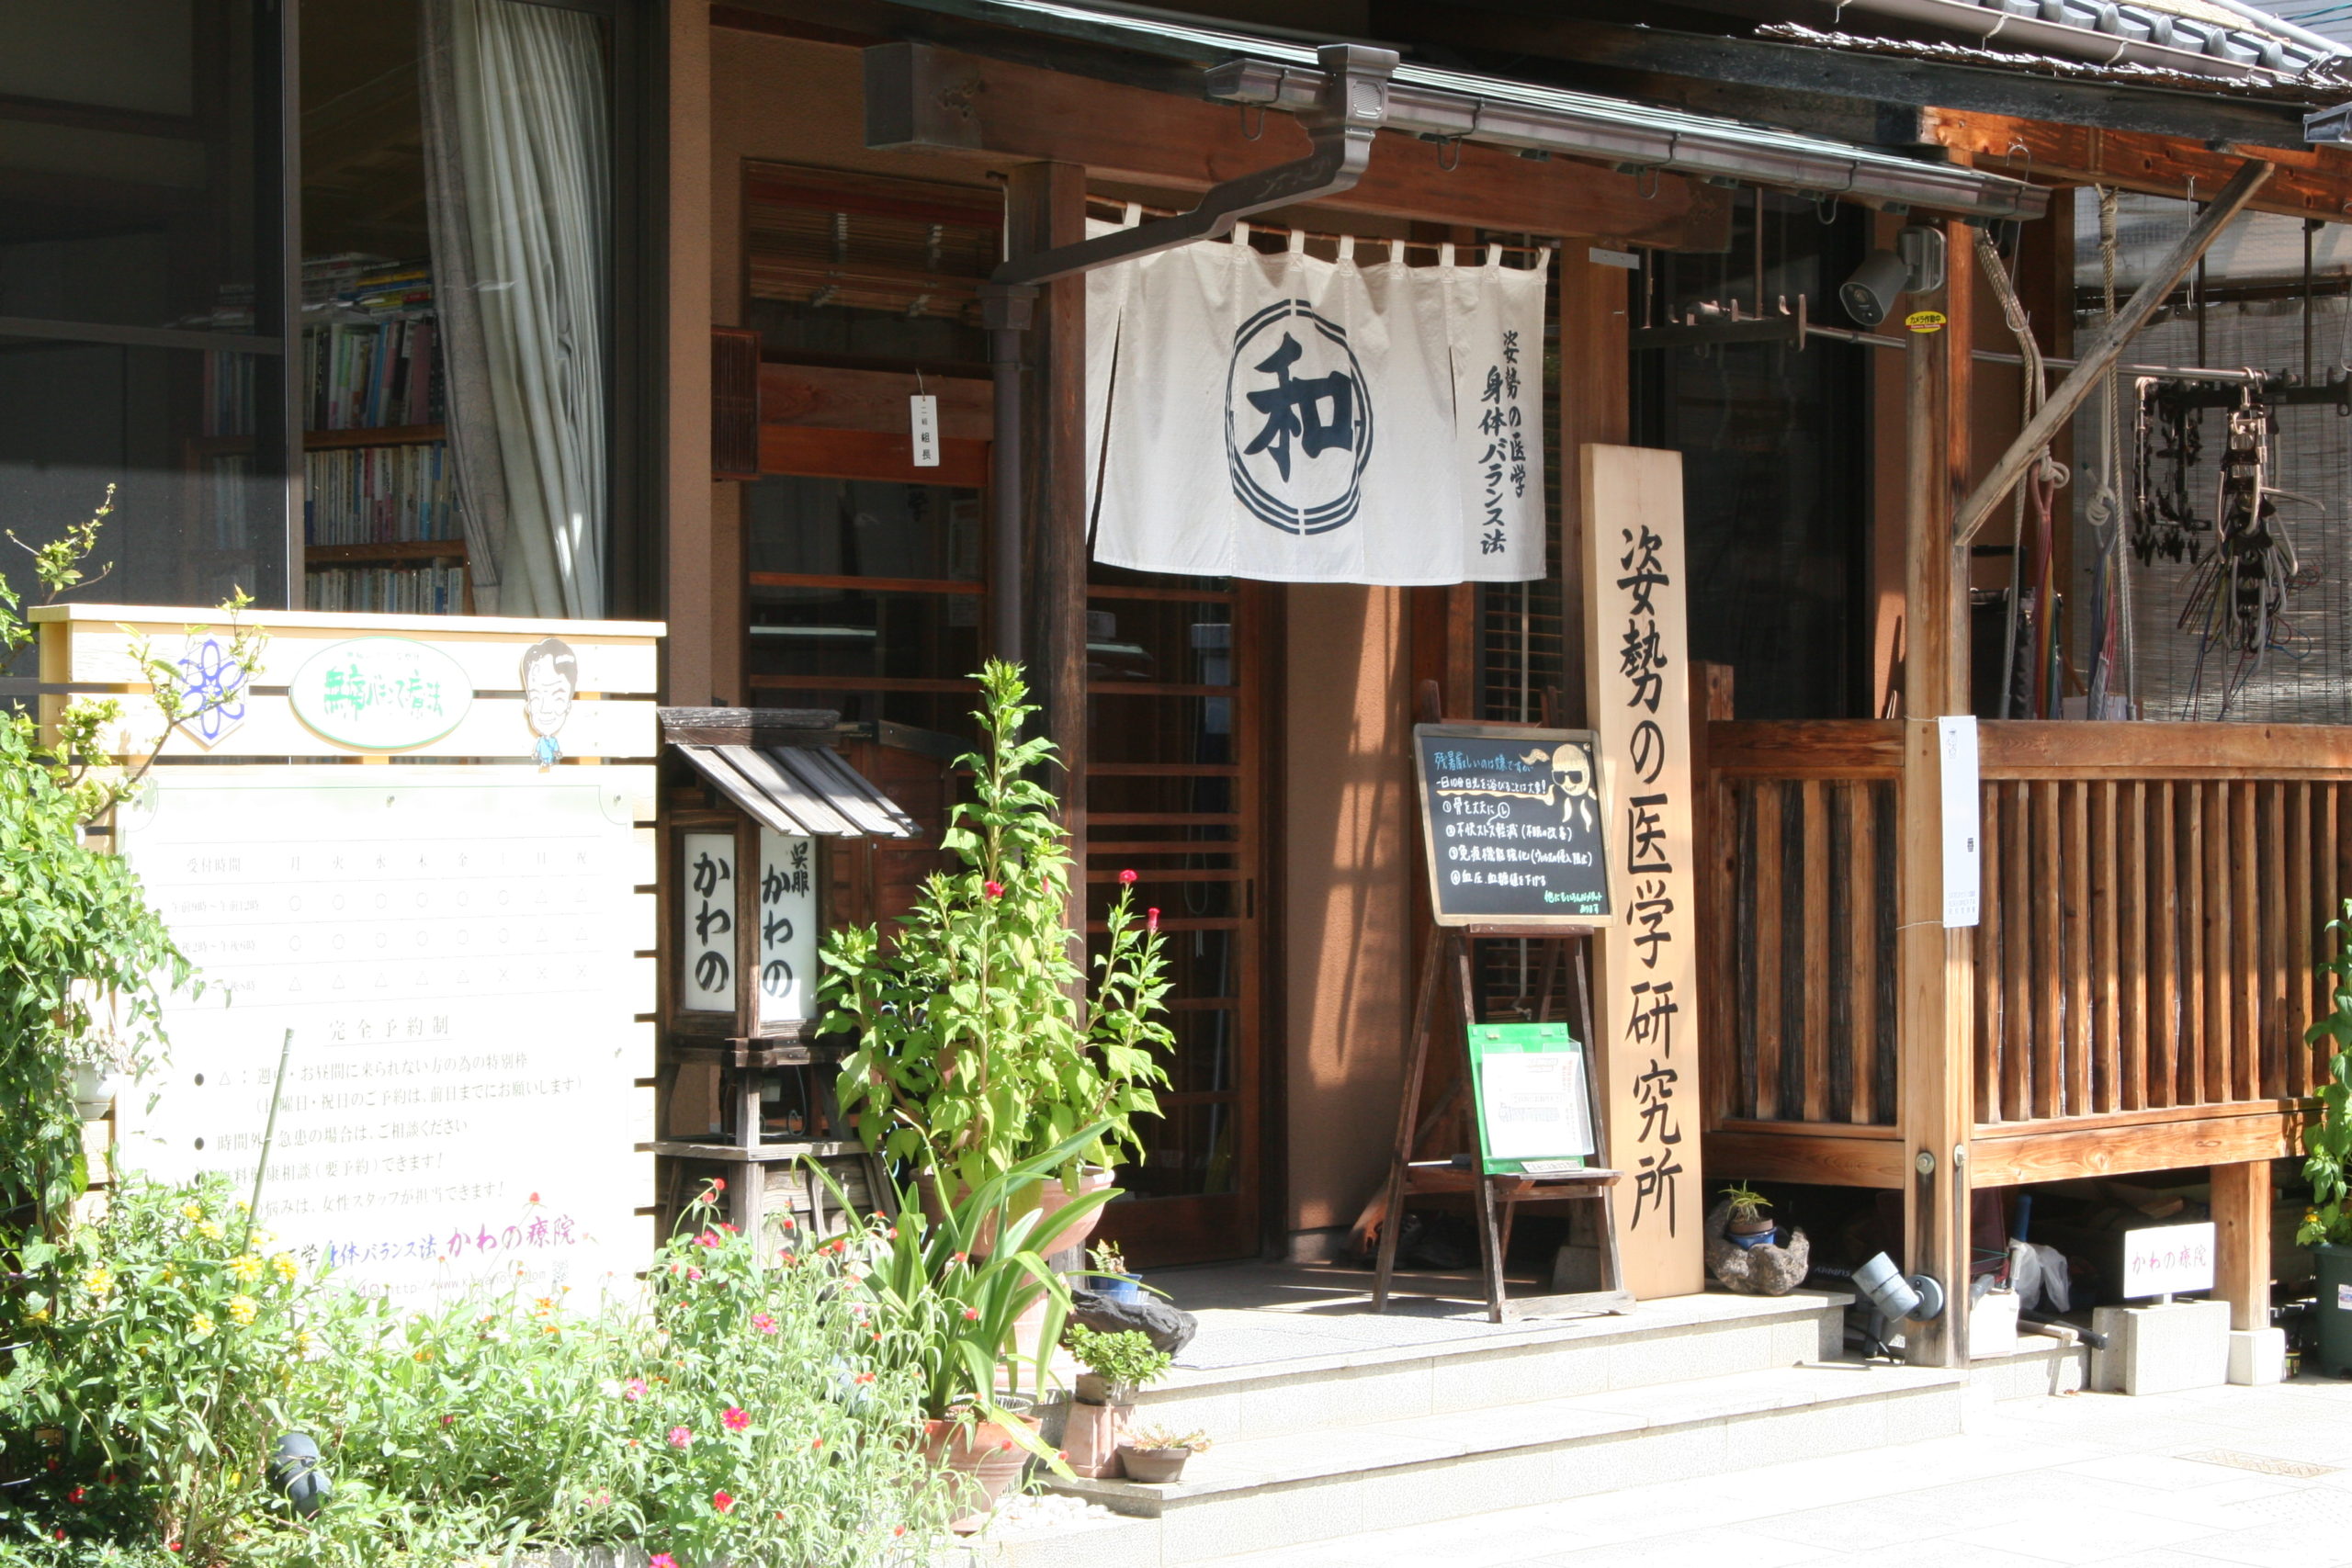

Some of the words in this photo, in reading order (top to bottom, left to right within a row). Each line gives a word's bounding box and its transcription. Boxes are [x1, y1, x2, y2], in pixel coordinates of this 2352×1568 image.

[1244, 331, 1353, 482] 和
[1478, 365, 1507, 554] 身体バランス法
[1503, 330, 1526, 498] 姿勢の医学
[693, 851, 731, 994] かわの
[762, 863, 794, 999] かわの
[790, 841, 810, 898] 呉服
[1616, 525, 1682, 1239] 姿勢の医学研究所
[329, 1015, 449, 1041] 完全予約制
[447, 1213, 576, 1258] かわの療院
[2132, 1244, 2207, 1275] かわの療院
